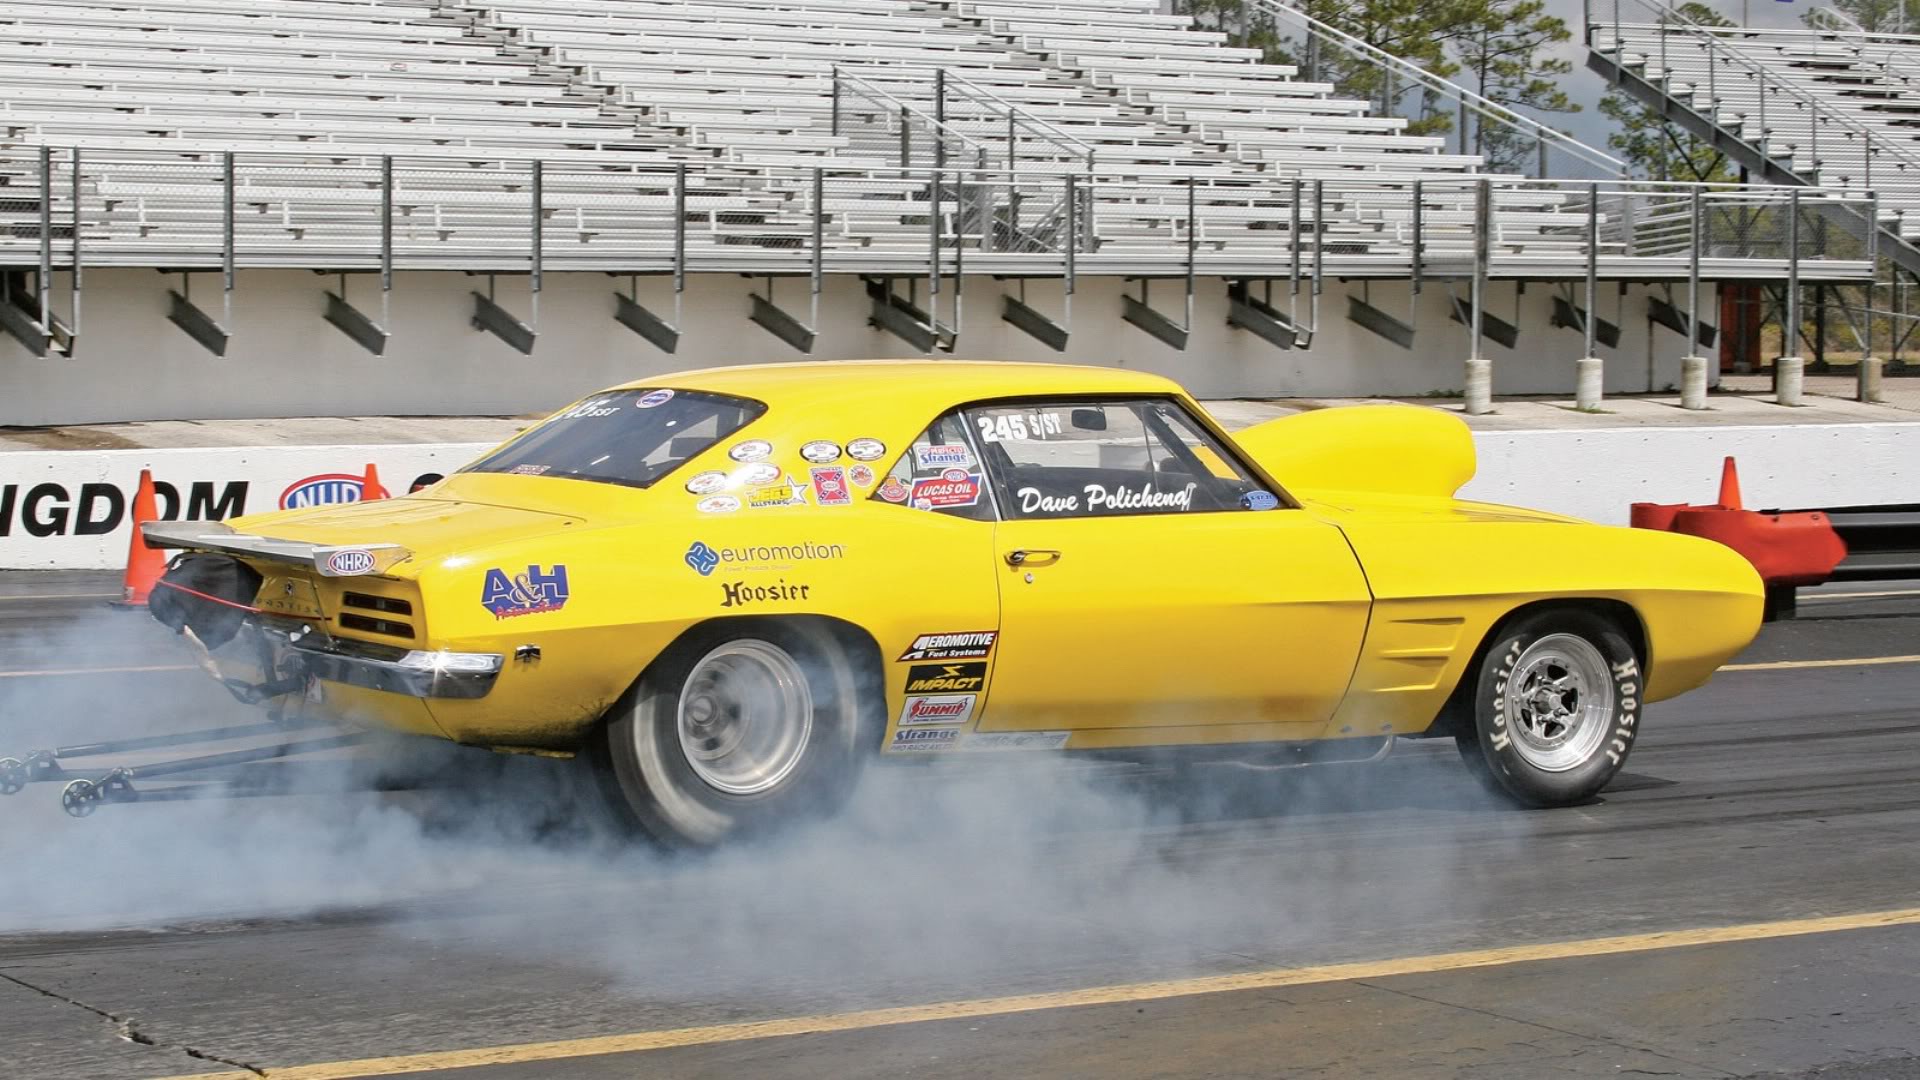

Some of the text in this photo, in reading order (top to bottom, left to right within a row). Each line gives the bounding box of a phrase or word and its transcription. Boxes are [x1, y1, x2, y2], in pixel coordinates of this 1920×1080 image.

[977, 413, 1062, 442] 245 S/ST
[919, 452, 967, 464] Strange
[917, 483, 955, 497] LUCAS
[954, 483, 972, 494] OIL
[1017, 487, 1079, 513] Dave
[0, 481, 249, 538] GDM
[335, 553, 369, 570] NHRA
[721, 541, 843, 563] euromotion
[481, 564, 570, 613] A&H
[720, 578, 809, 607] Hoosier
[903, 633, 995, 657] AEROMOTIVE
[927, 649, 986, 658] Fuel Systems
[907, 677, 982, 691] IMPACT
[1490, 641, 1521, 751] Hoosier
[1607, 657, 1638, 765] Hoosier
[895, 728, 960, 740] Strange
